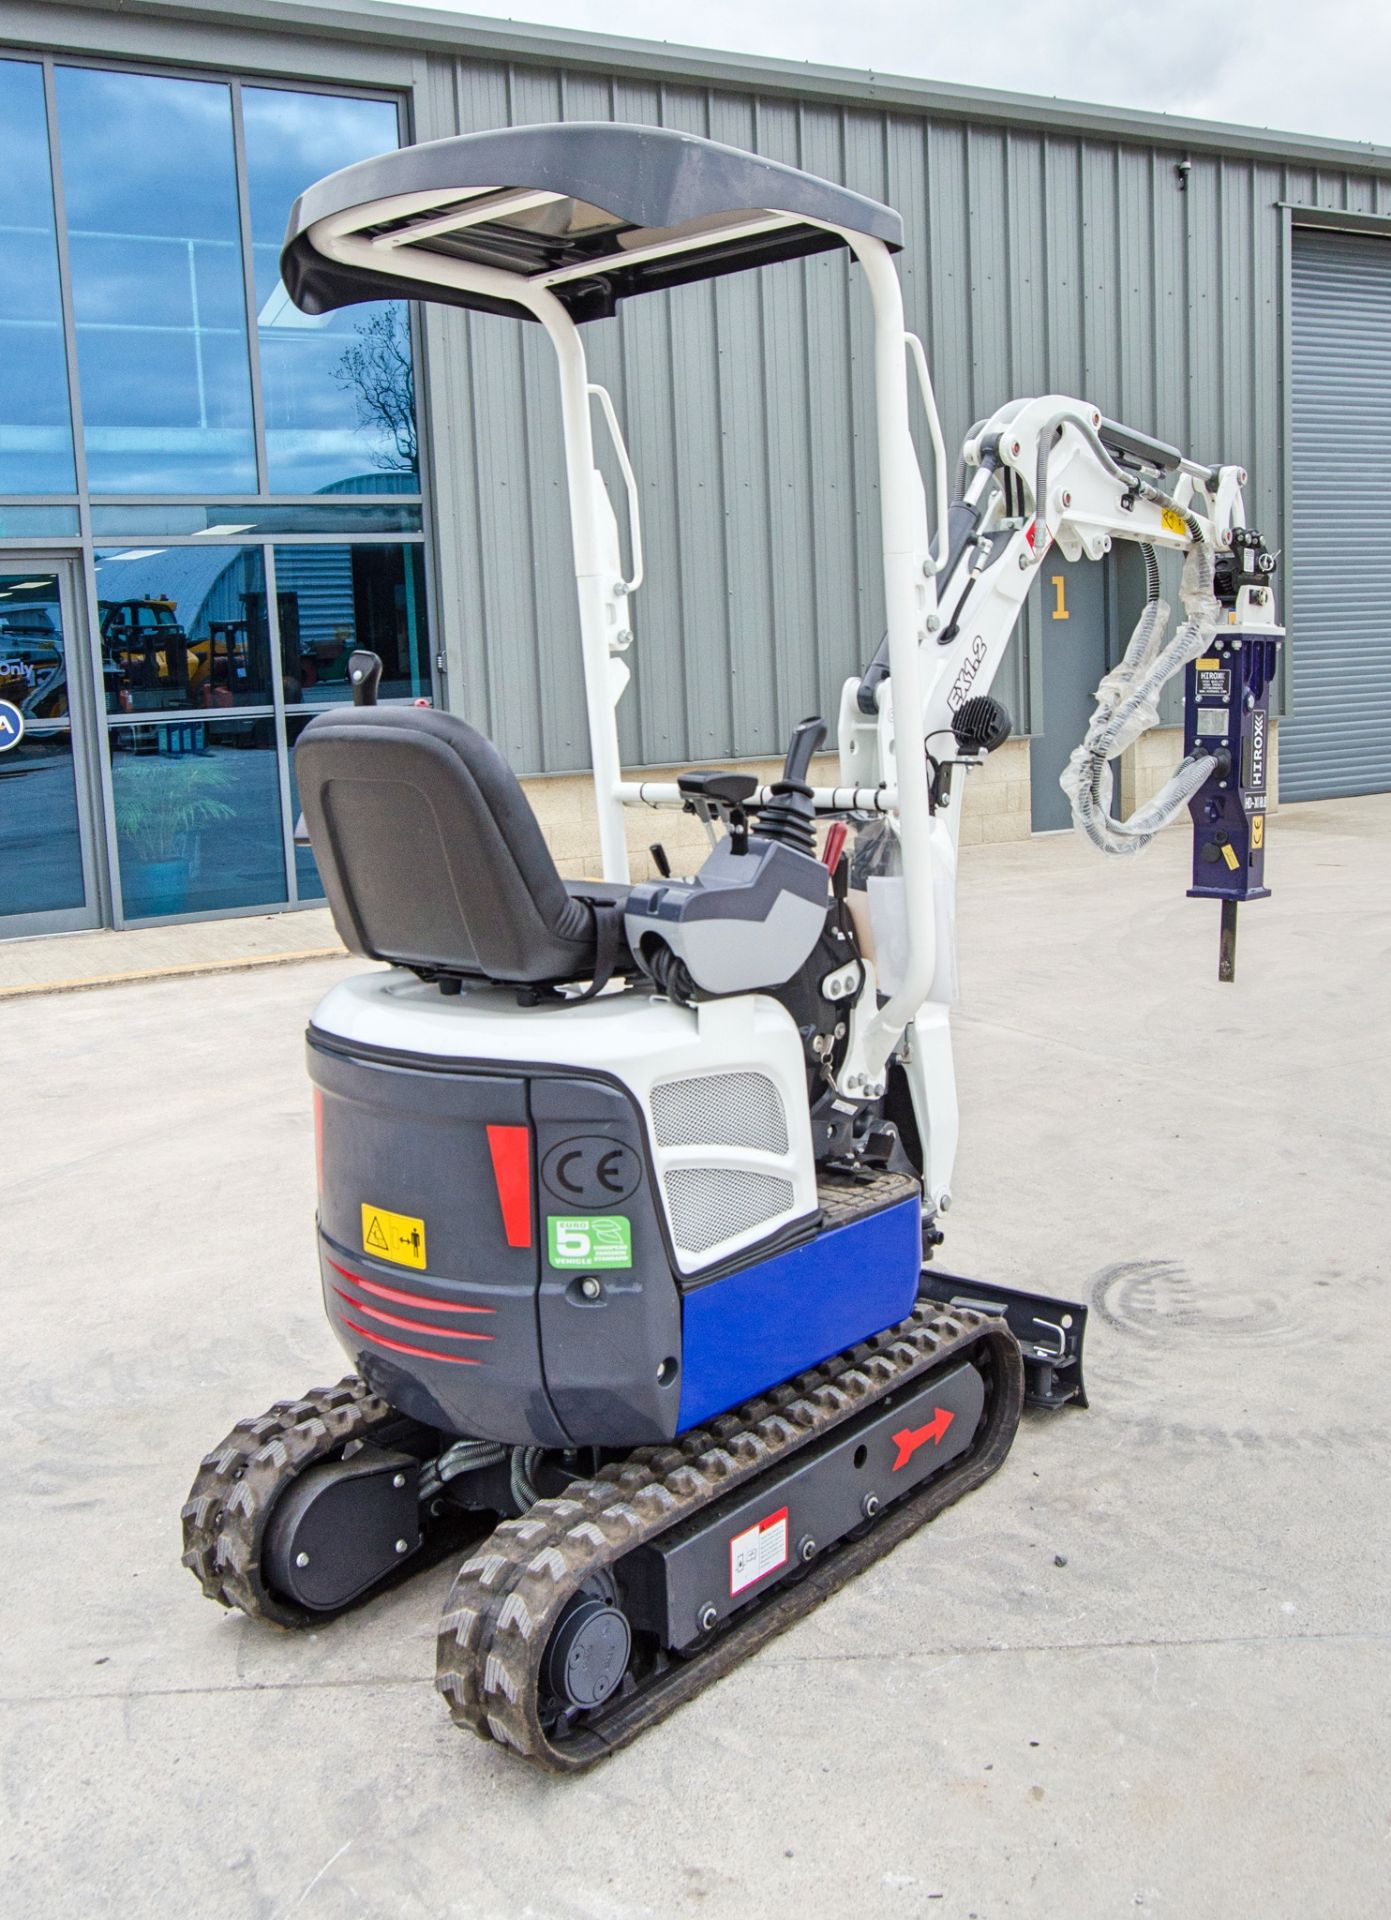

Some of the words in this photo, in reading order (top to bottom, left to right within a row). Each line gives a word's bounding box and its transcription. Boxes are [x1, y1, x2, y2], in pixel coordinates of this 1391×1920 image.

[1051, 575, 1070, 620] 1
[0, 662, 33, 679] Only
[1253, 818, 1262, 845] CE
[556, 1150, 624, 1194] CE
[556, 1220, 591, 1257] 5
